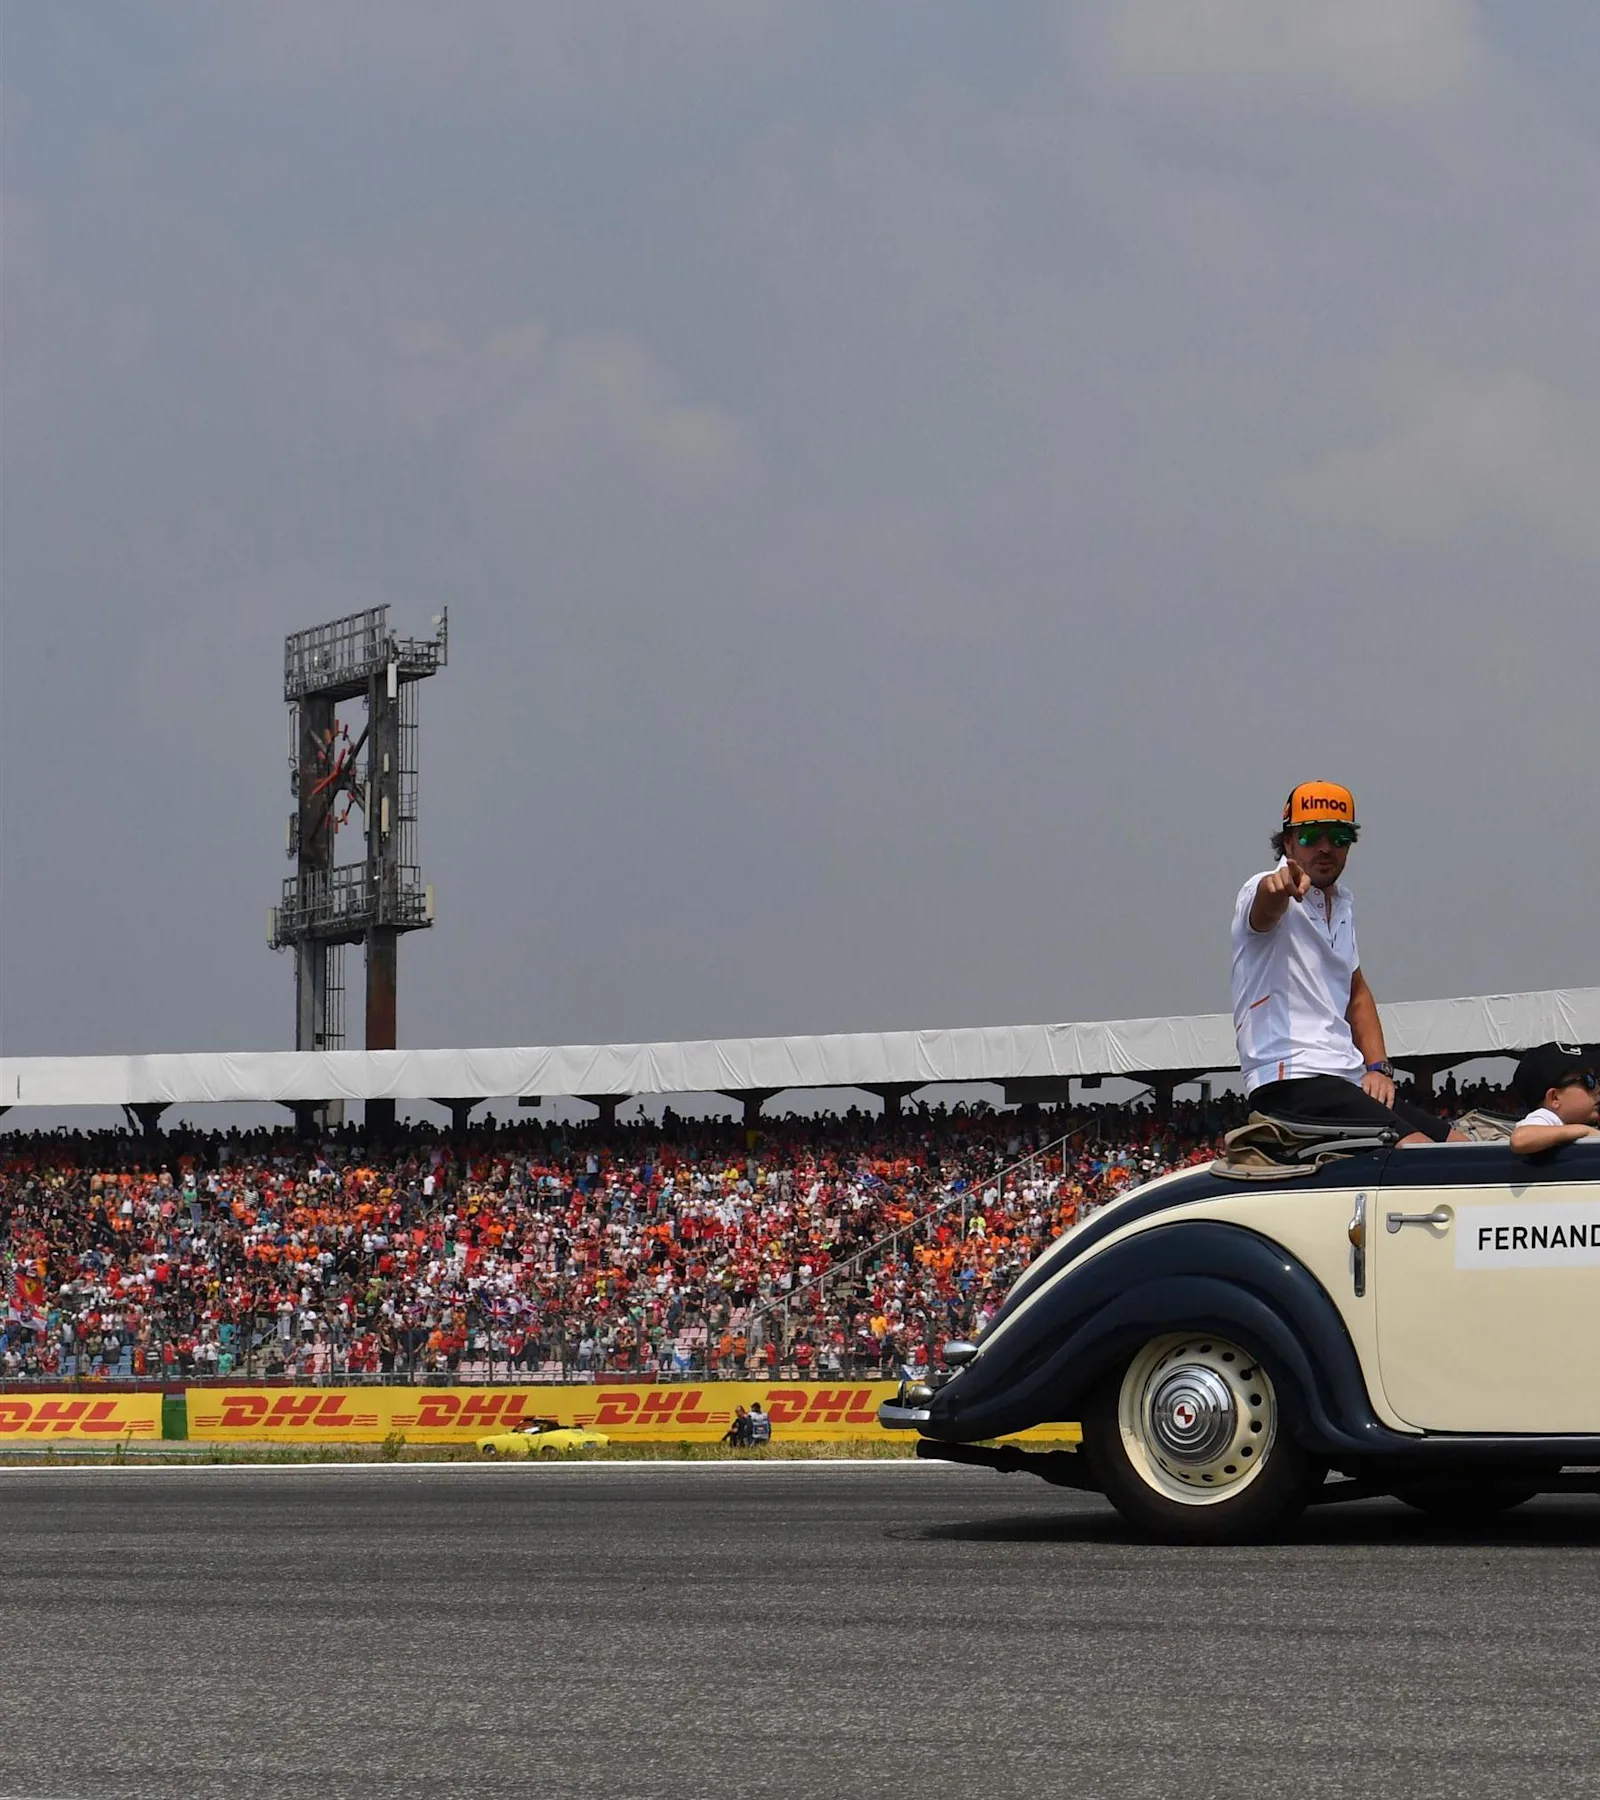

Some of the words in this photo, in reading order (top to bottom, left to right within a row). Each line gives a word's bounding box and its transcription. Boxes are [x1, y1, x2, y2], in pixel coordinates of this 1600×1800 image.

[1302, 796, 1347, 813] kimoa
[220, 1396, 354, 1426] DHL
[416, 1395, 536, 1426] DHL
[595, 1392, 710, 1424] DHL
[766, 1390, 879, 1423] DHL
